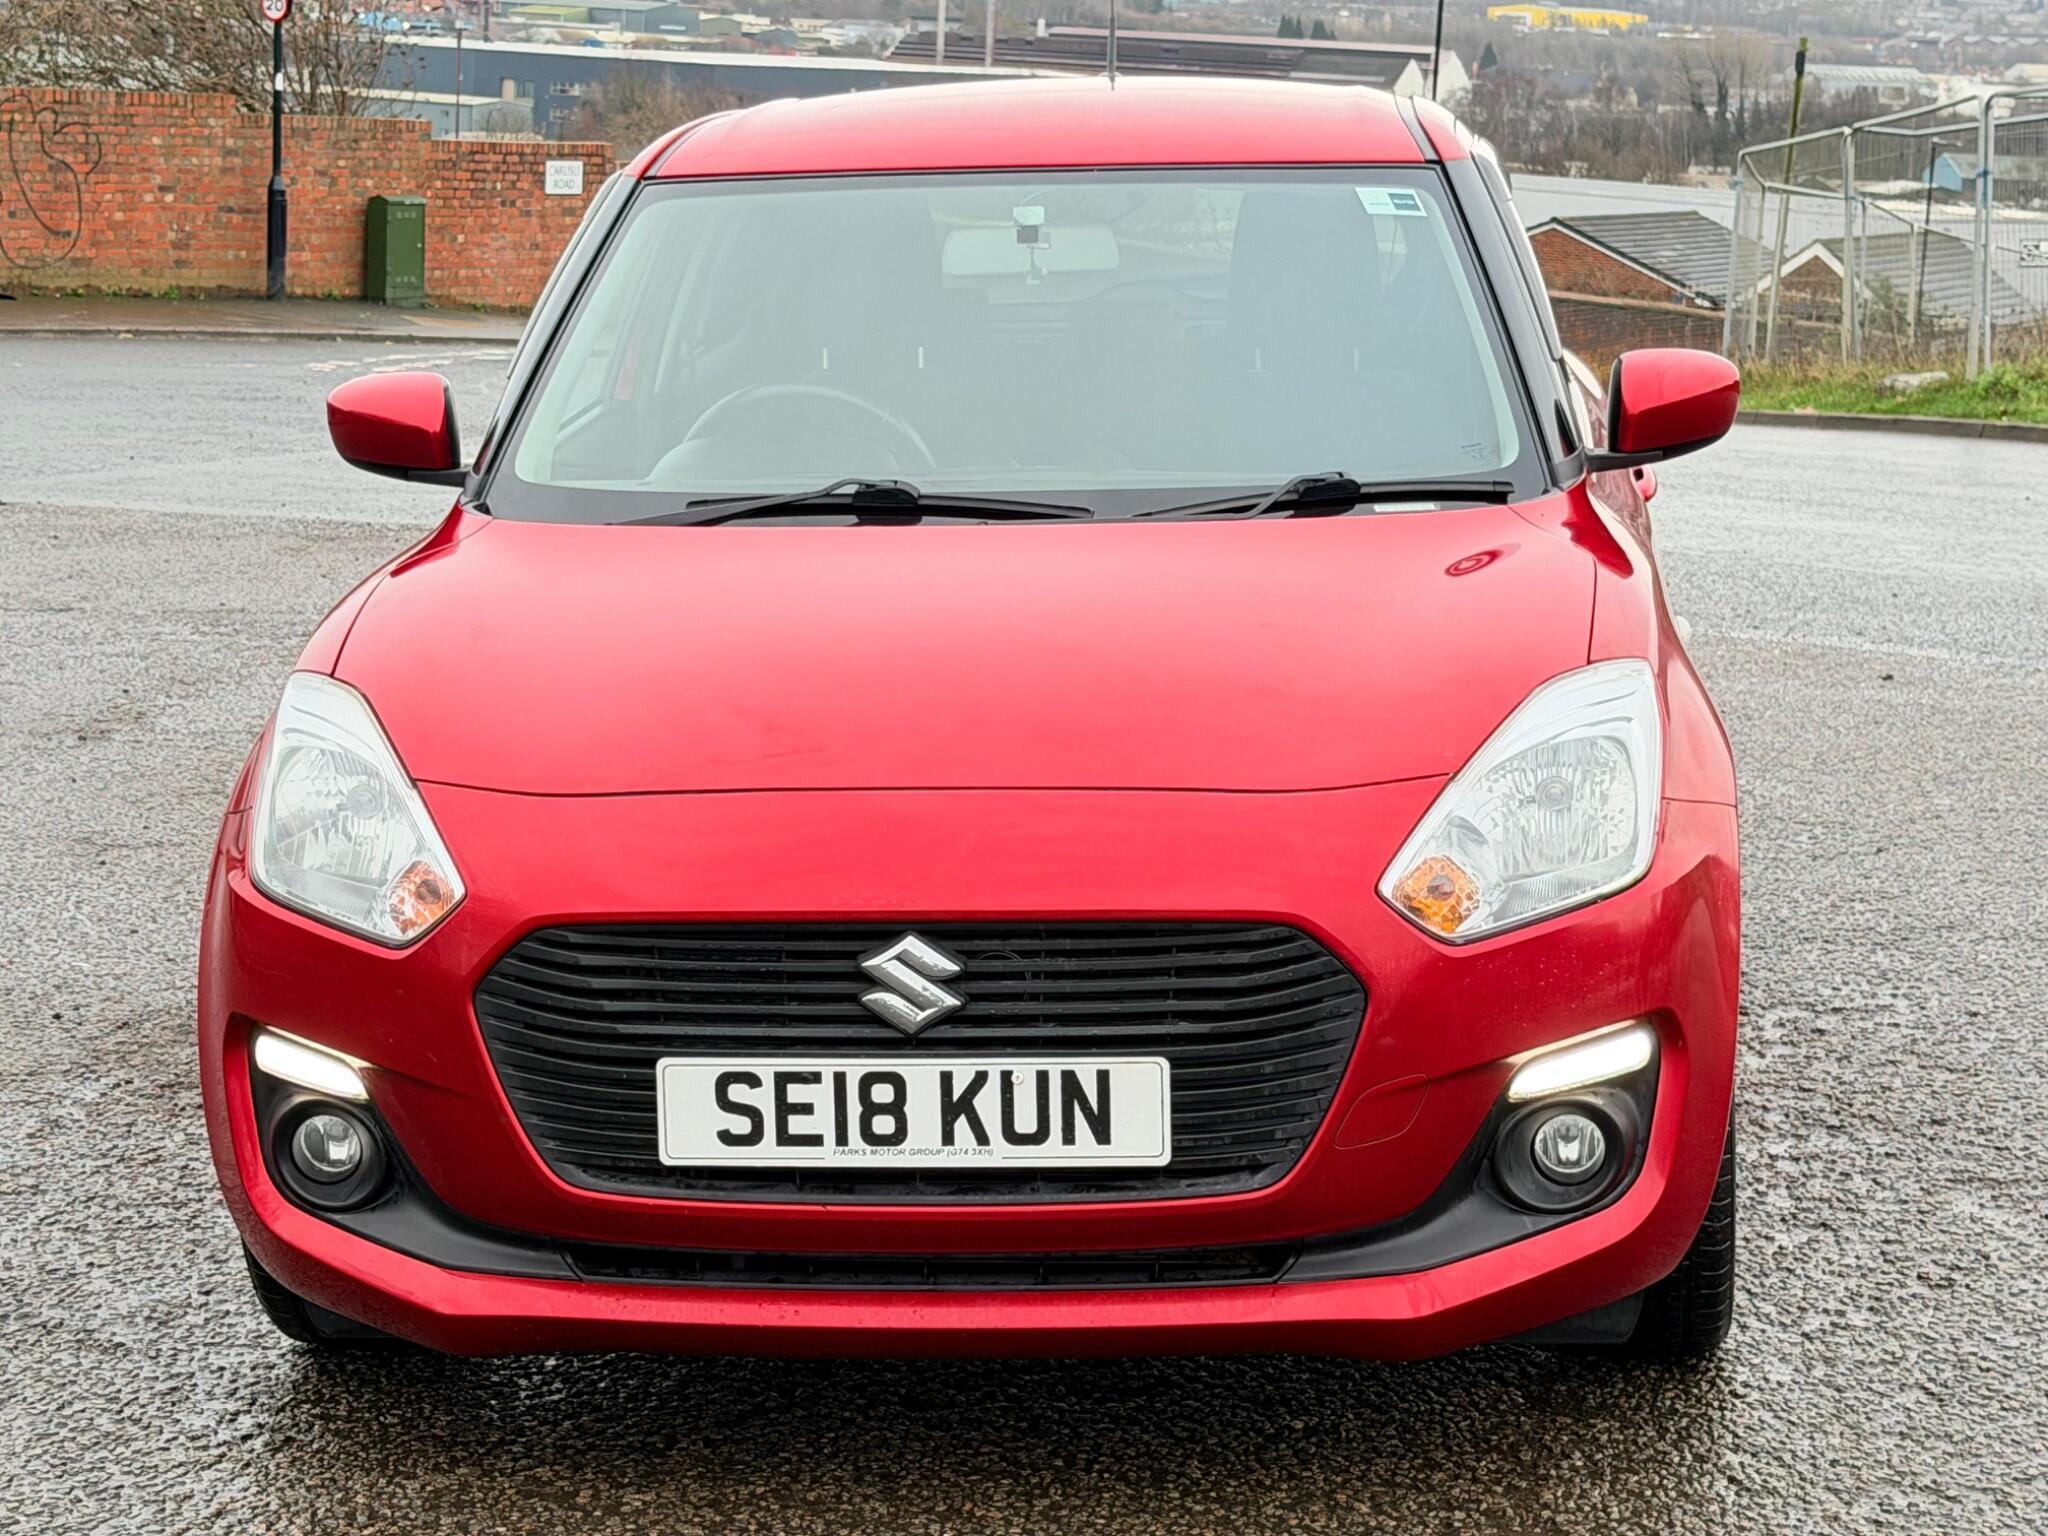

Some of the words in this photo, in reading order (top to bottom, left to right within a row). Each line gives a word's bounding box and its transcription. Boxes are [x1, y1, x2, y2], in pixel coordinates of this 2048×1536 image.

[266, 0, 283, 11] 20
[553, 179, 576, 190] ROAD
[714, 1071, 909, 1148] SE18
[939, 1068, 1112, 1147] KUN
[832, 1148, 867, 1157] PARKS
[869, 1148, 906, 1157] MOTOR
[908, 1148, 945, 1157] GROUP
[946, 1148, 969, 1158] (G74
[970, 1148, 994, 1157] 3XH)
